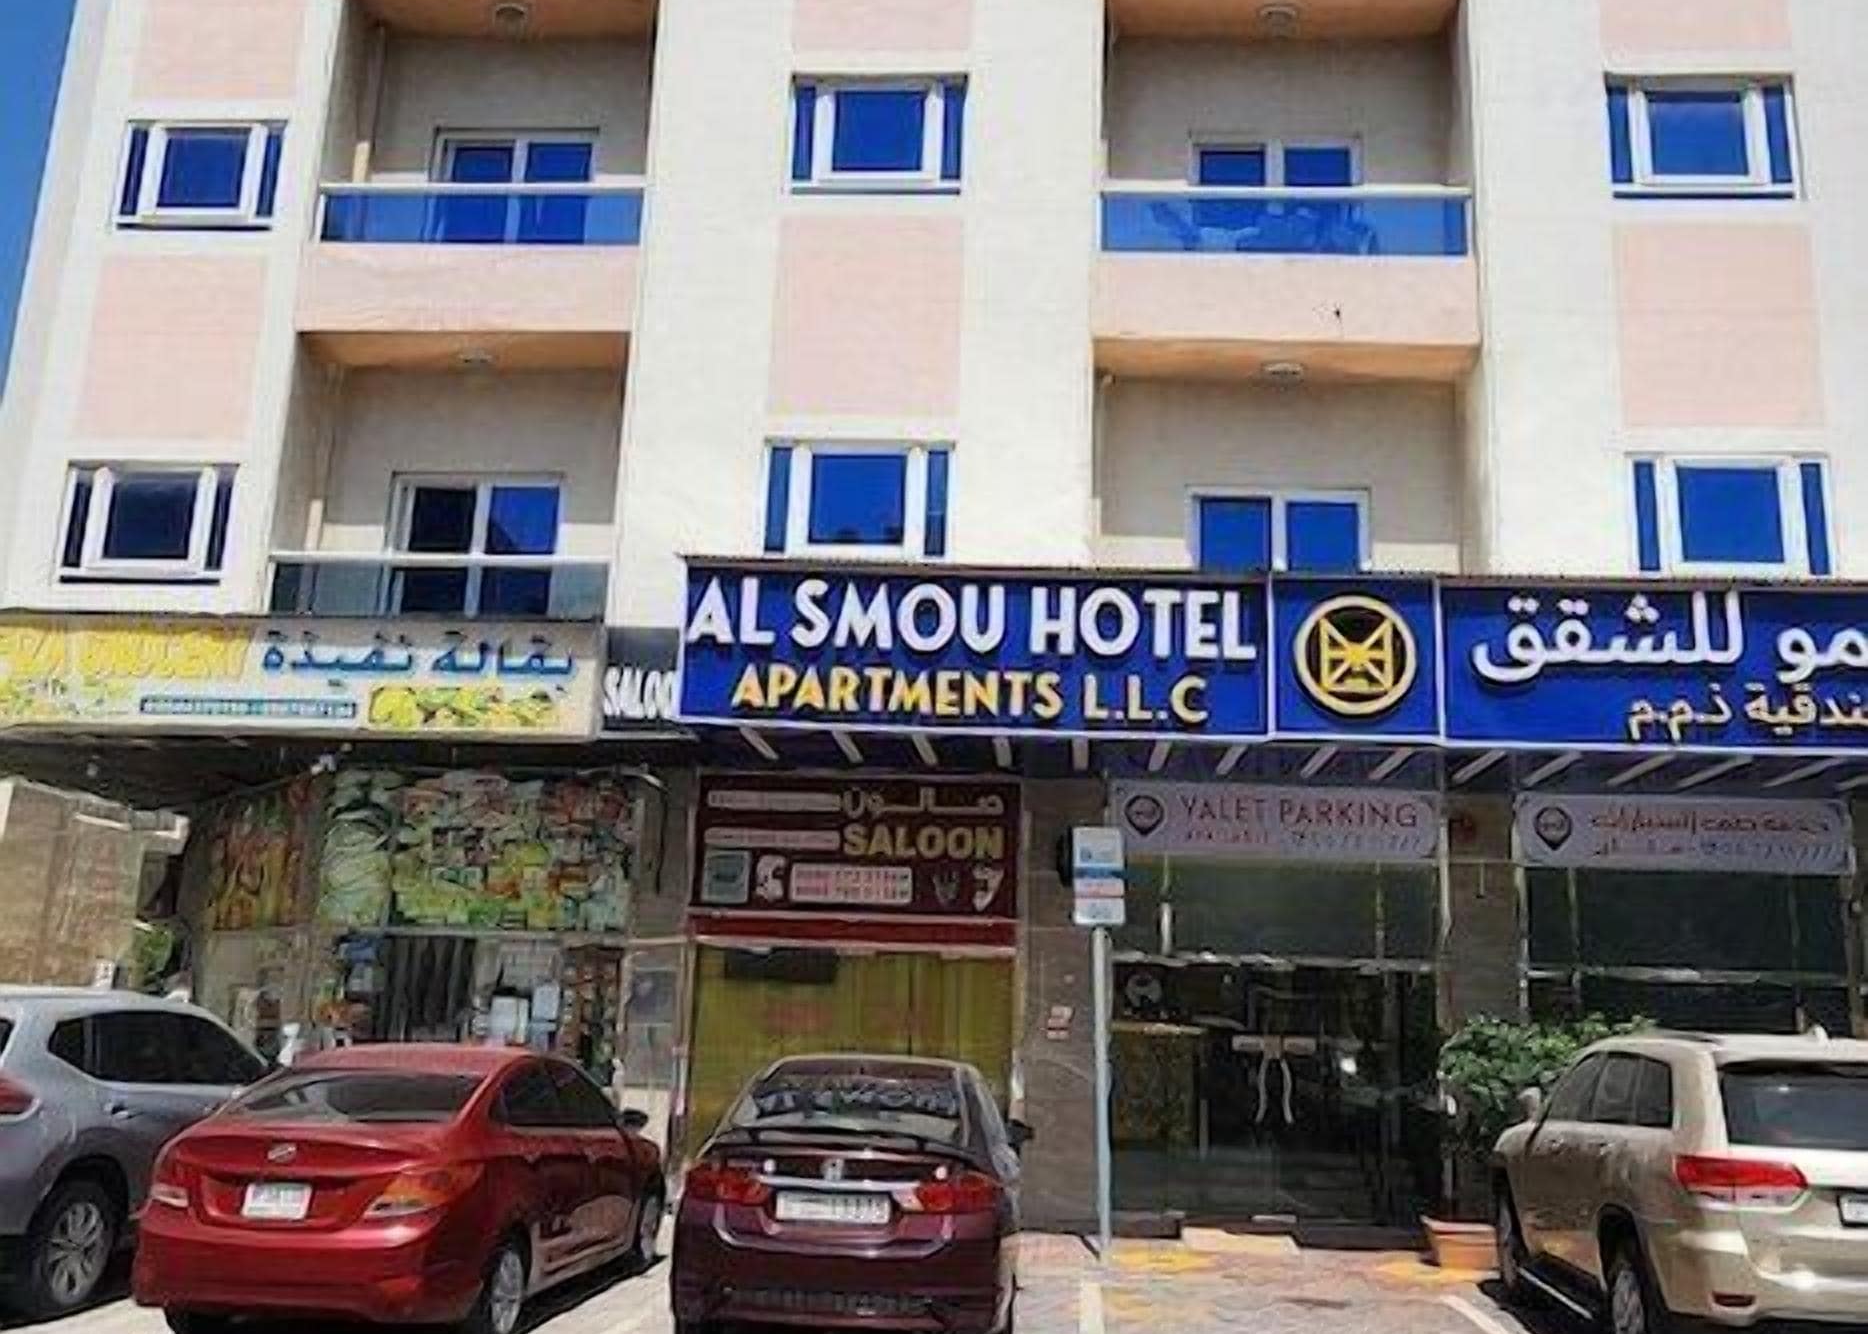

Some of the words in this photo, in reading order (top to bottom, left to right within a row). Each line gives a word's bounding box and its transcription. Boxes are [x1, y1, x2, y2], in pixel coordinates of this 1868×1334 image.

[687, 577, 775, 645] AL
[791, 578, 1005, 655] SMOU
[1031, 585, 1257, 661] HOTEL
[1472, 592, 1743, 683] للشقق
[263, 630, 413, 687] نفيذة
[432, 630, 572, 691] بقالة
[732, 664, 1064, 720] APARTMENTS
[1083, 674, 1208, 723] L.L.C
[843, 787, 1005, 818] صالون
[1279, 797, 1417, 828] PARKING
[843, 823, 1005, 859] SALOON
